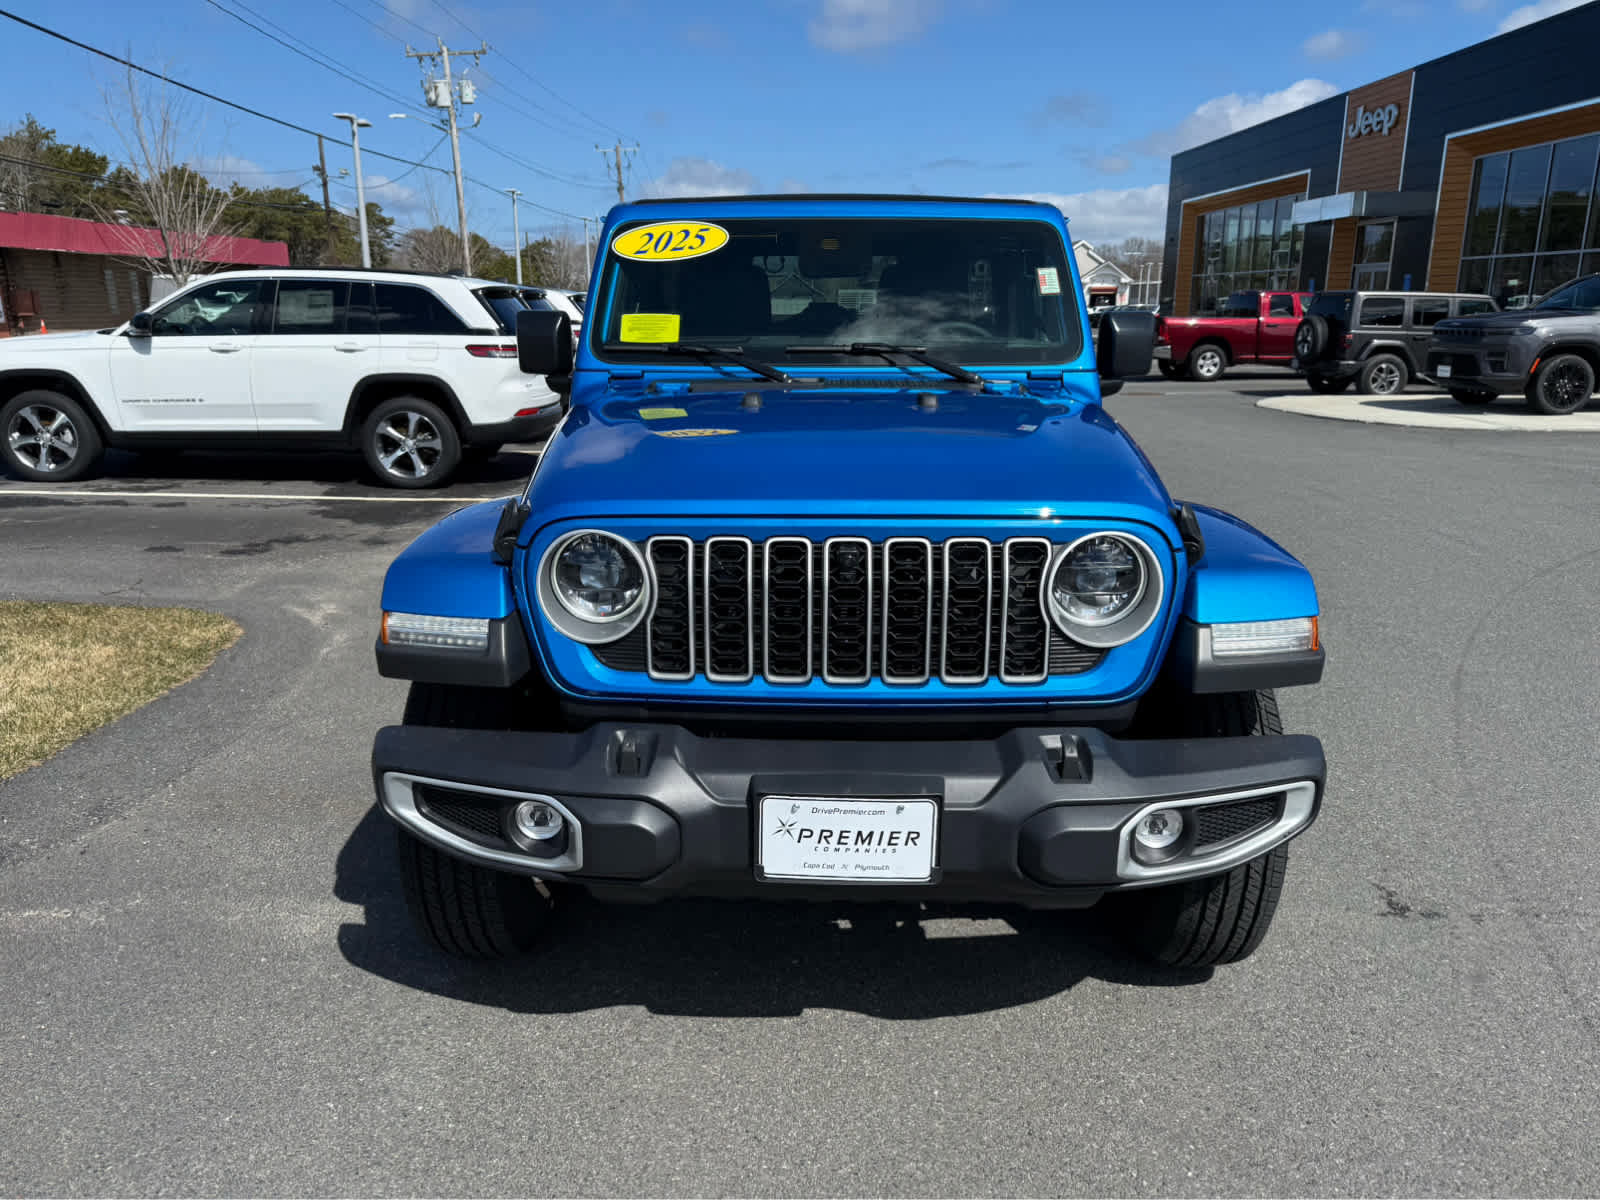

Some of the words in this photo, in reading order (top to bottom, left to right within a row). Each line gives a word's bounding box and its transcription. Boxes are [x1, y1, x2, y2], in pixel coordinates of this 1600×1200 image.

[1348, 104, 1399, 138] Jeep
[633, 228, 710, 255] 2025
[811, 807, 886, 816] DrivePremier.com
[797, 828, 921, 846] PREMIER
[814, 846, 897, 854] COMPANIES
